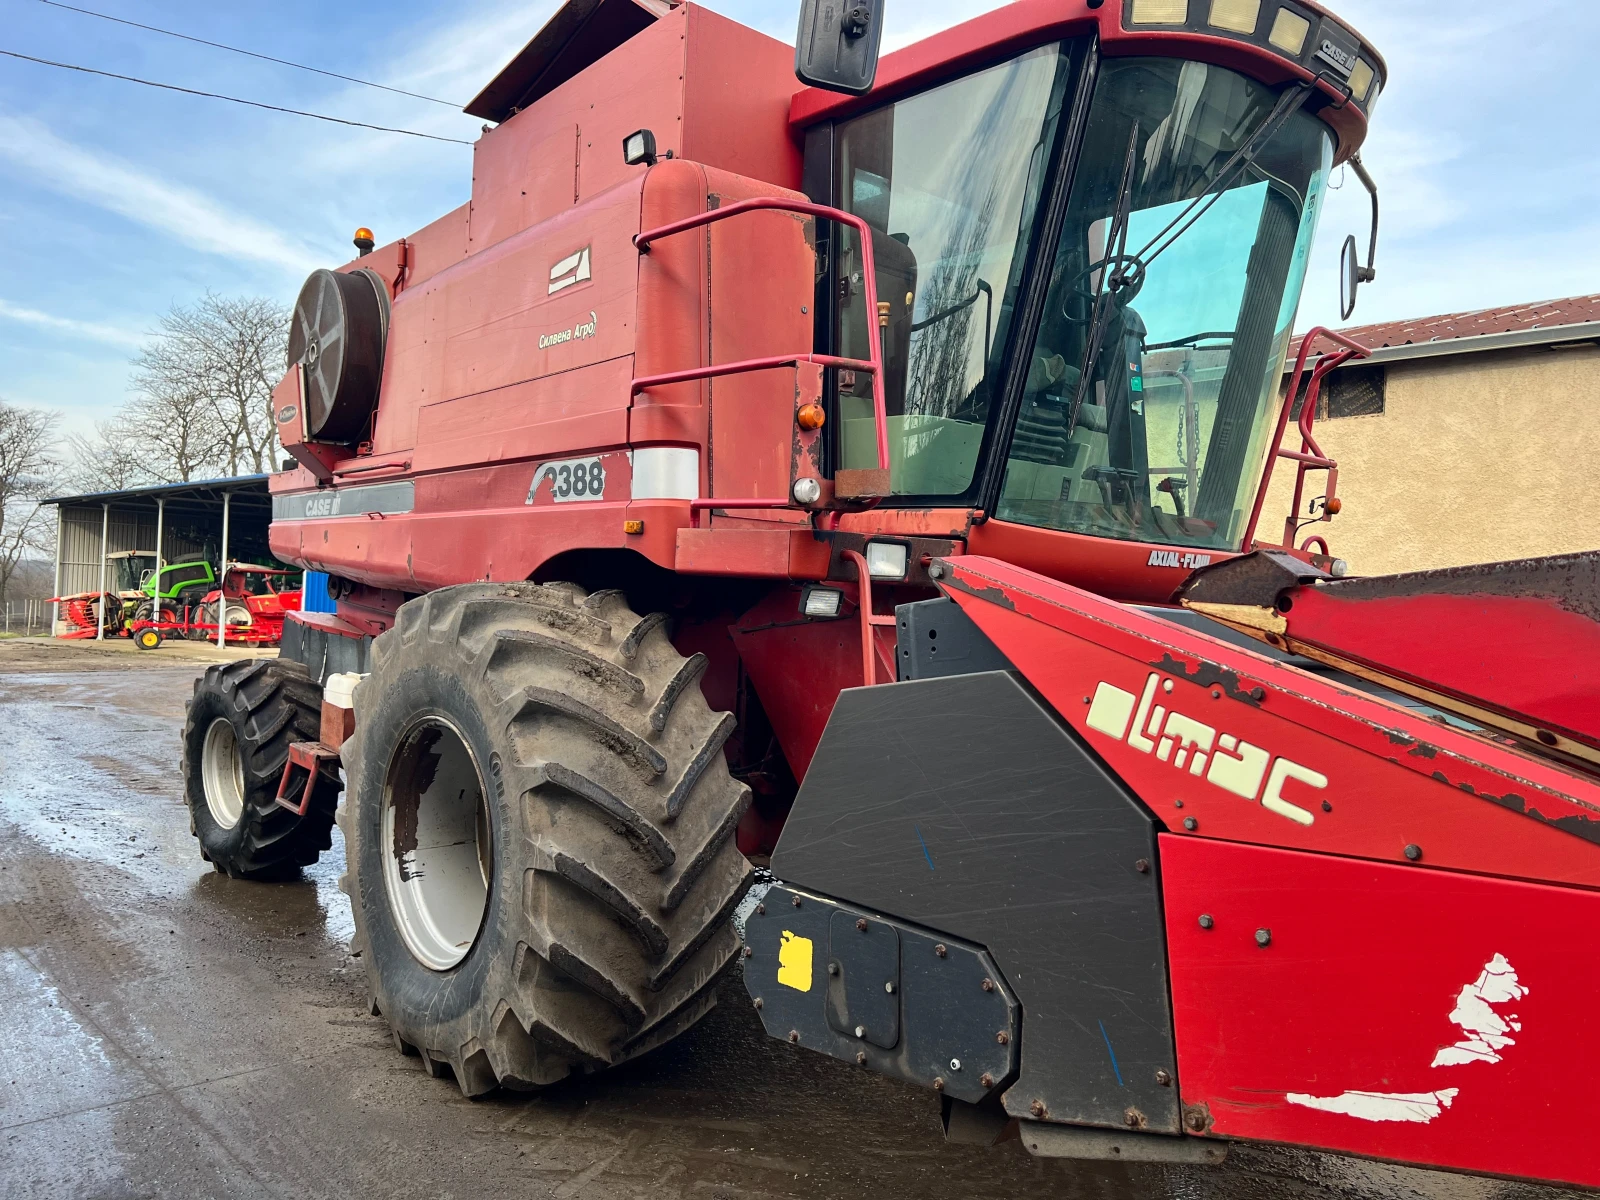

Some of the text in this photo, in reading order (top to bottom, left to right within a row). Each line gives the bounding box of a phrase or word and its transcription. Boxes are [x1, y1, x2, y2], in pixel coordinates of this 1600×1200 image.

[1322, 39, 1348, 65] CASE
[539, 321, 595, 349] Силвена Агро
[305, 498, 331, 517] CASE
